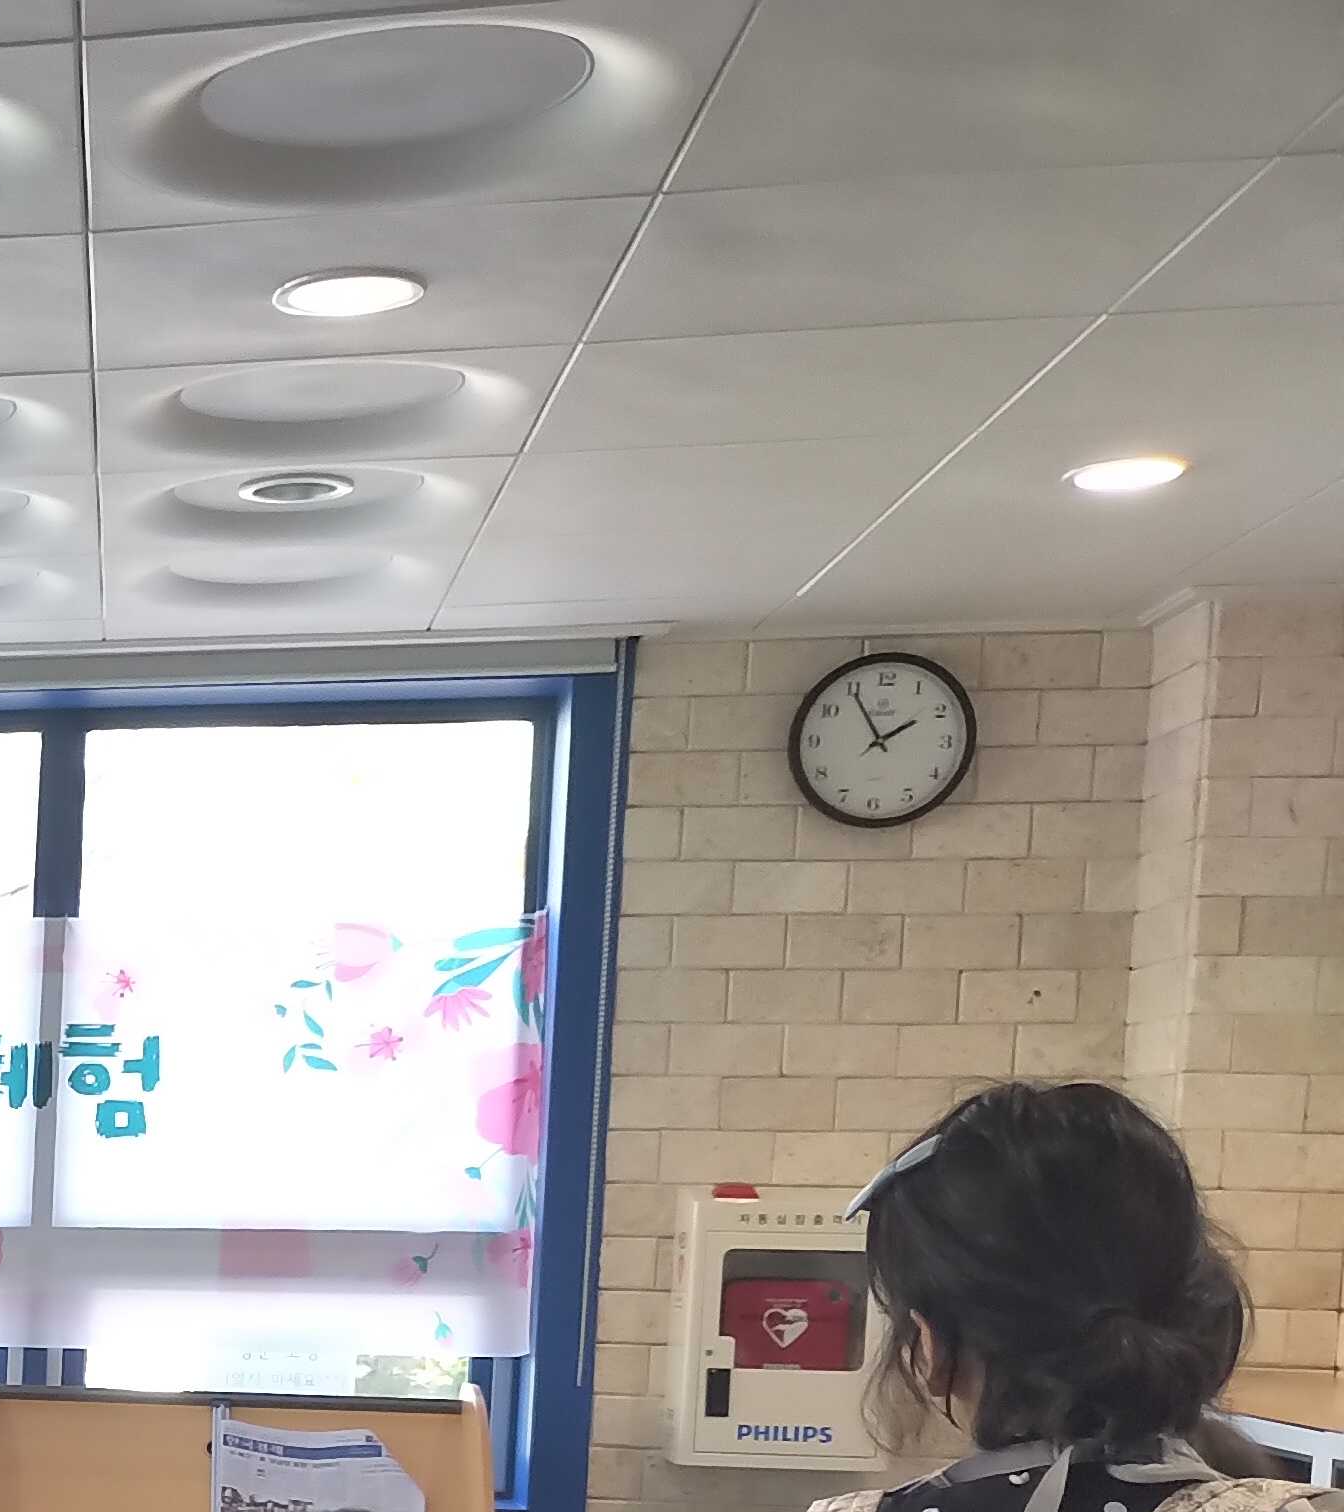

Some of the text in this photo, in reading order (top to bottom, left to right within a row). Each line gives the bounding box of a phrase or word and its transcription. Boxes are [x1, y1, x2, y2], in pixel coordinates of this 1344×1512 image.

[879, 672, 897, 687] 12
[914, 681, 922, 695] 1
[821, 703, 839, 718] 10
[934, 704, 946, 719] 2
[808, 734, 821, 749] 9
[940, 735, 952, 750] 3
[815, 766, 828, 781] 8
[929, 766, 939, 780] 4
[838, 789, 850, 803] 7
[901, 788, 914, 803] 5
[867, 797, 880, 811] 6
[737, 1423, 833, 1444] PHILIPS
